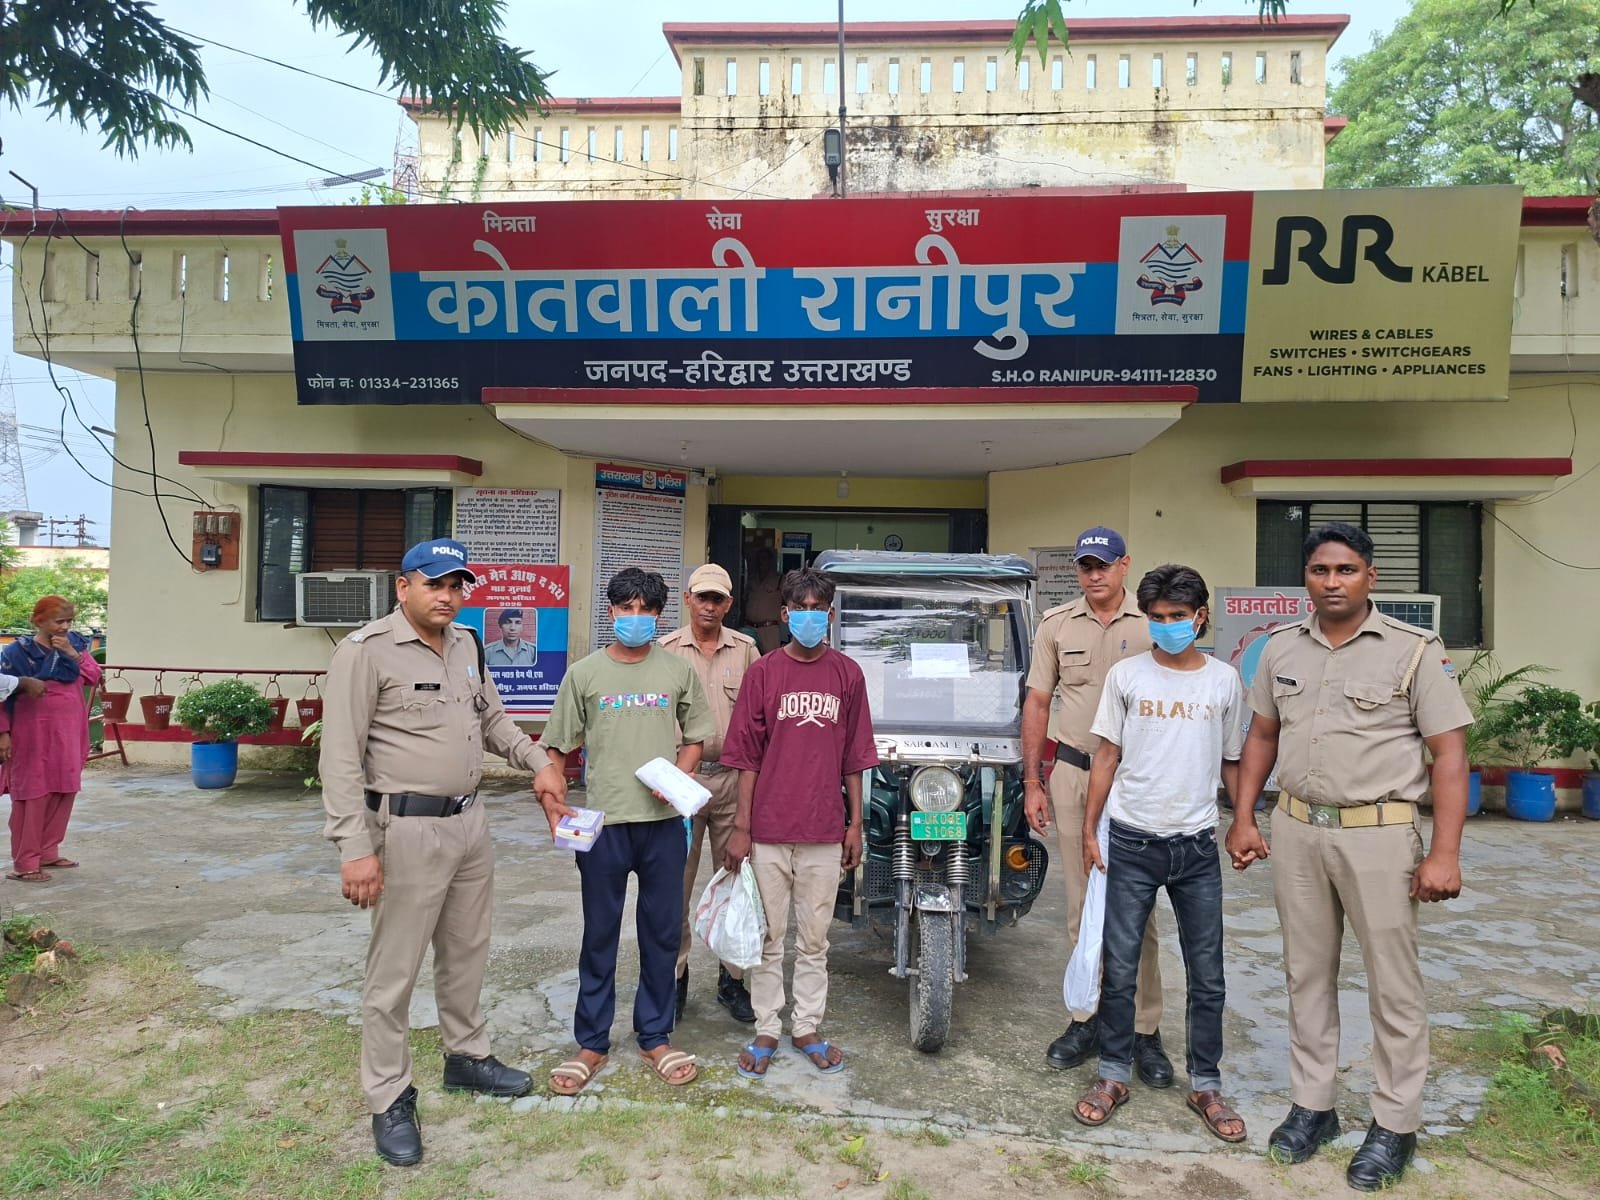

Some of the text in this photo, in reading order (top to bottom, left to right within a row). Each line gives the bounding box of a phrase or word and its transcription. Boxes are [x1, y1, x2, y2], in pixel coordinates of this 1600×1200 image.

[483, 210, 536, 233] मित्रता
[706, 206, 742, 231] सेवा
[925, 208, 980, 233] सुरक्षा
[1262, 214, 1413, 285] RR
[419, 233, 1087, 361] कोतवाली रानीपुर
[1310, 328, 1434, 341] WIRES & CABLES
[1269, 346, 1472, 359] SWITCHES SWITCHGEARS
[584, 350, 912, 384] जनपद-हरिद्वार उत्तराखण्ड
[1039, 367, 1217, 382] RANIPUR-94111-12830
[1253, 364, 1486, 377] FANS LIGHTING APPLIANCES
[307, 372, 335, 391] फोन
[359, 377, 459, 390] 01334-231365
[600, 469, 683, 490] उत्तराखण्ड पुलिस
[1080, 536, 1109, 547] POLICE
[1224, 592, 1301, 616] डाउनलोड
[599, 693, 669, 710] FUTURE
[777, 692, 840, 724] JORDAN
[903, 740, 949, 749] SARAM
